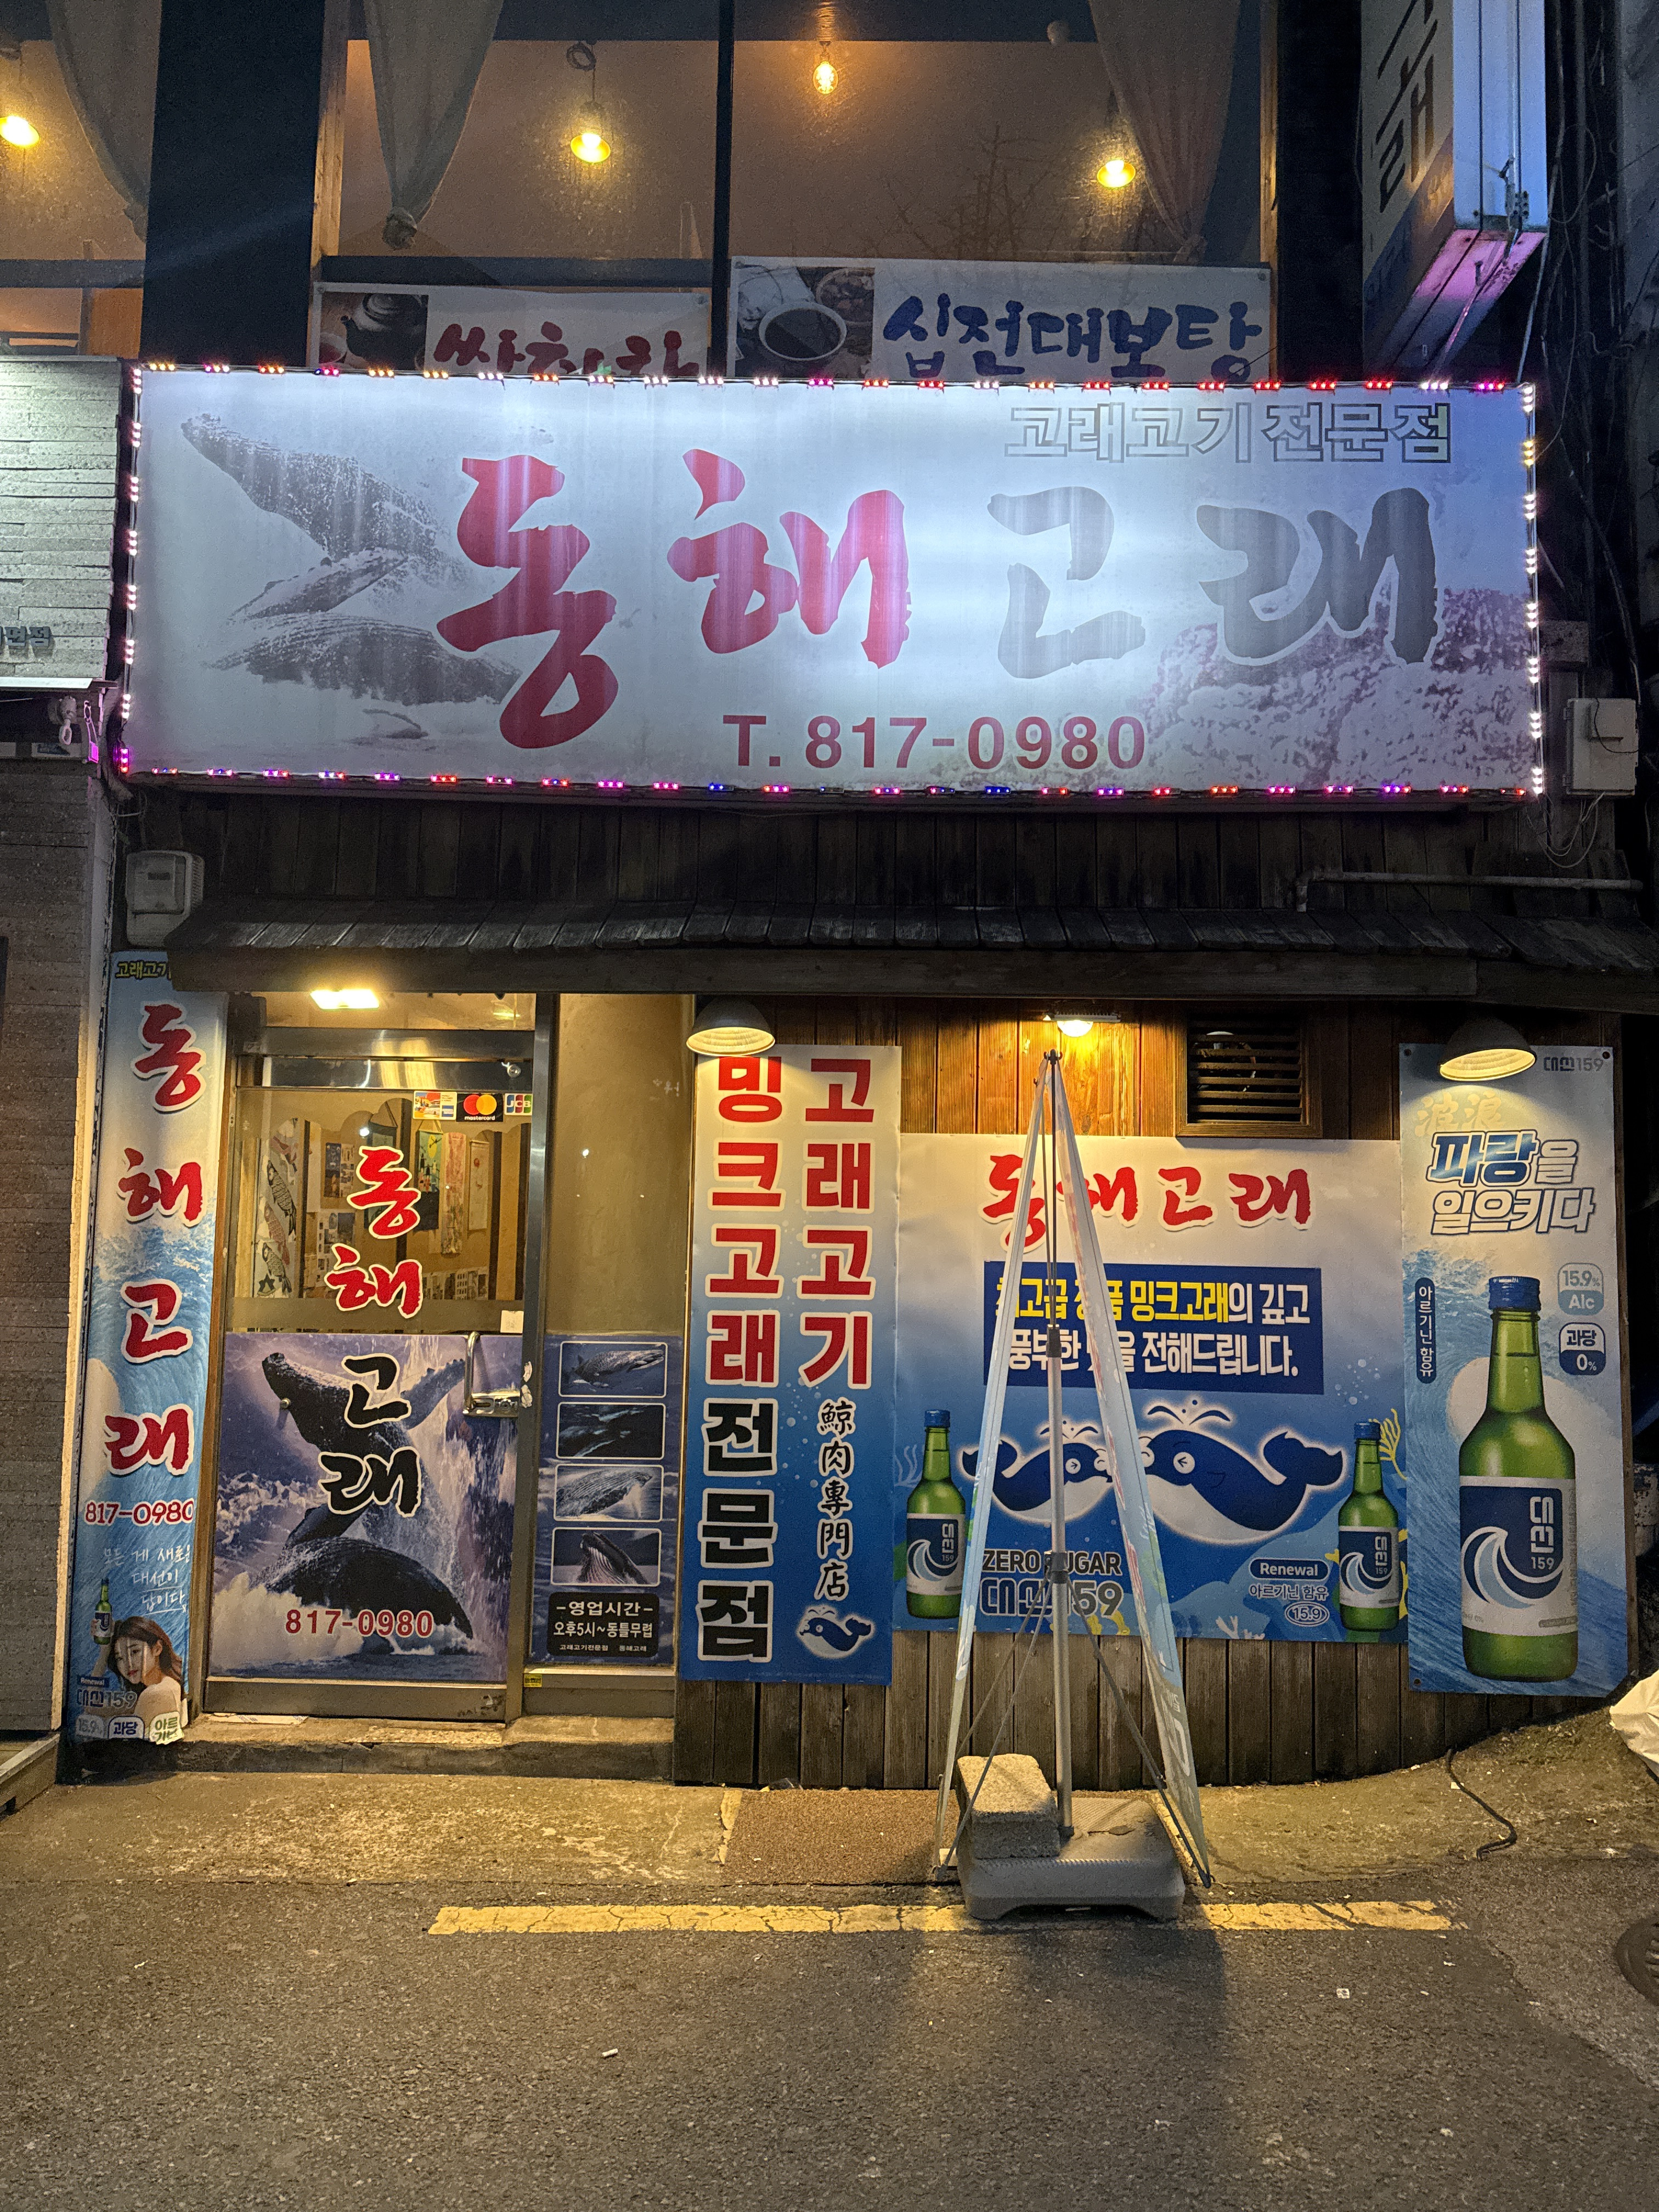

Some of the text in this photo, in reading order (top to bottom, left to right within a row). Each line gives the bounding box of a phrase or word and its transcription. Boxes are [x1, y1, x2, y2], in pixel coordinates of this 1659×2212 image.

[883, 292, 1262, 383] 십전대보탕
[723, 715, 1145, 769] T. 817-0980
[506, 1100, 532, 1108] JCB
[1427, 1130, 1579, 1187] 파랑을
[1430, 1188, 1596, 1235] 일으키다
[800, 1058, 874, 1385] 고래고기
[1562, 1270, 1600, 1286] 15.9%
[1130, 1281, 1253, 1324] 밍크고래의
[1261, 1284, 1311, 1325] 깊고
[1568, 1294, 1595, 1309] Alc
[1418, 1286, 1434, 1377] 아르기닌 함유
[1566, 1329, 1597, 1347] 과당
[1087, 1334, 1136, 1373] 을
[1142, 1332, 1299, 1377] 전해드립니다.
[1576, 1353, 1597, 1371] 0%
[85, 1500, 194, 1525] 817-0980
[157, 1544, 191, 1564] 새로운
[982, 1549, 1122, 1576] ZERO UGAR
[1531, 1556, 1554, 1570] 159
[131, 1568, 178, 1587] 대선이
[1260, 1562, 1318, 1577] Renewal
[1375, 1567, 1388, 1575] 159
[140, 1589, 185, 1612] 답이다
[1249, 1583, 1329, 1601] 아르기닌 함유
[1292, 1606, 1323, 1620] 15.9
[285, 1609, 433, 1637] 817-0980
[80, 1677, 105, 1686] Renewal
[112, 1721, 138, 1736] 과당
